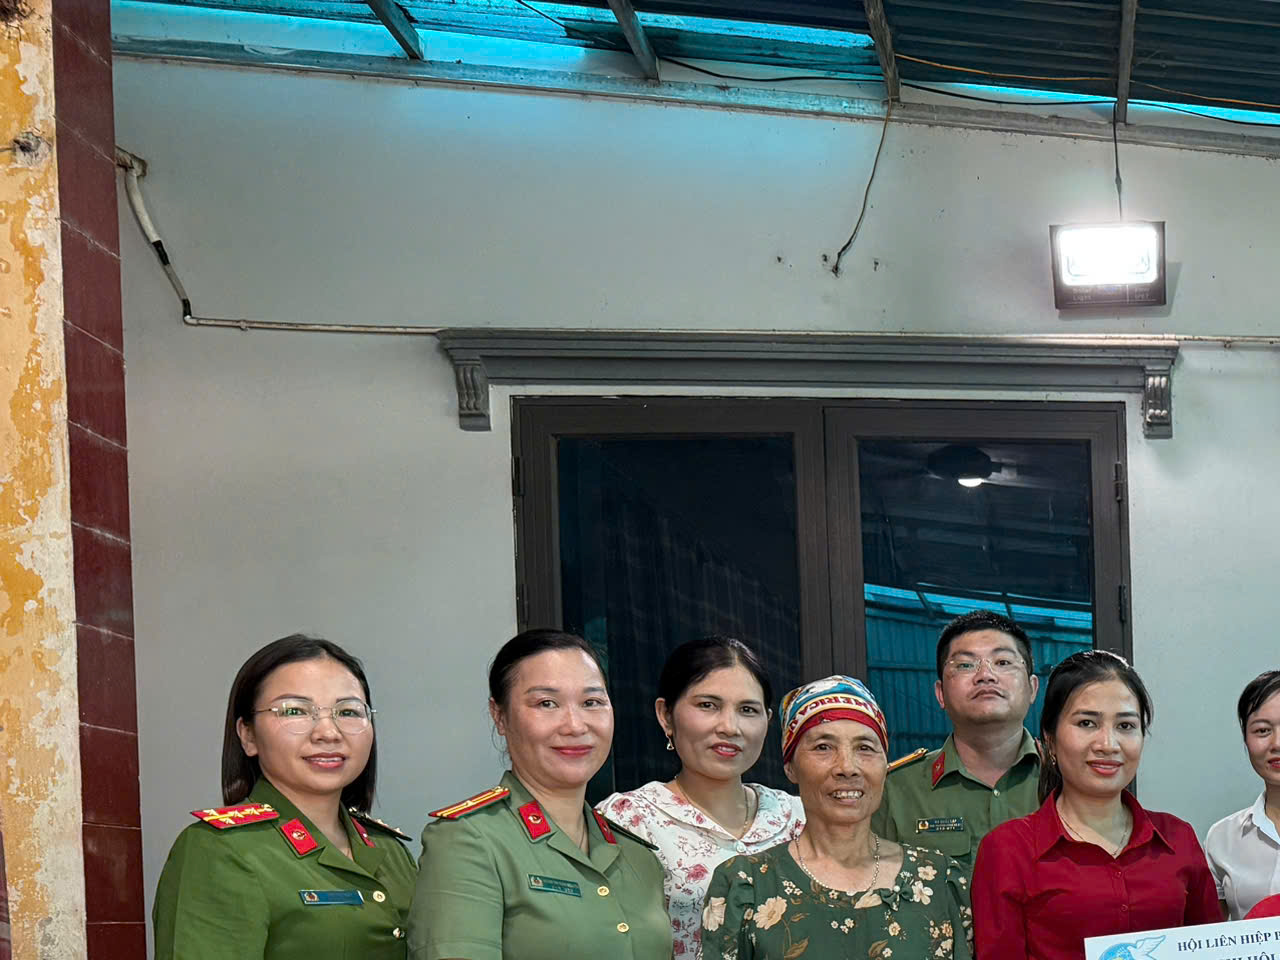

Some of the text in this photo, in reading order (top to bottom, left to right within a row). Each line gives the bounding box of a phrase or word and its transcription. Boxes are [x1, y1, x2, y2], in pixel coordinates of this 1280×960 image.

[1177, 938, 1202, 952] HỘI
[1206, 935, 1237, 949] LIÊN
[1240, 931, 1271, 945] HIỆP
